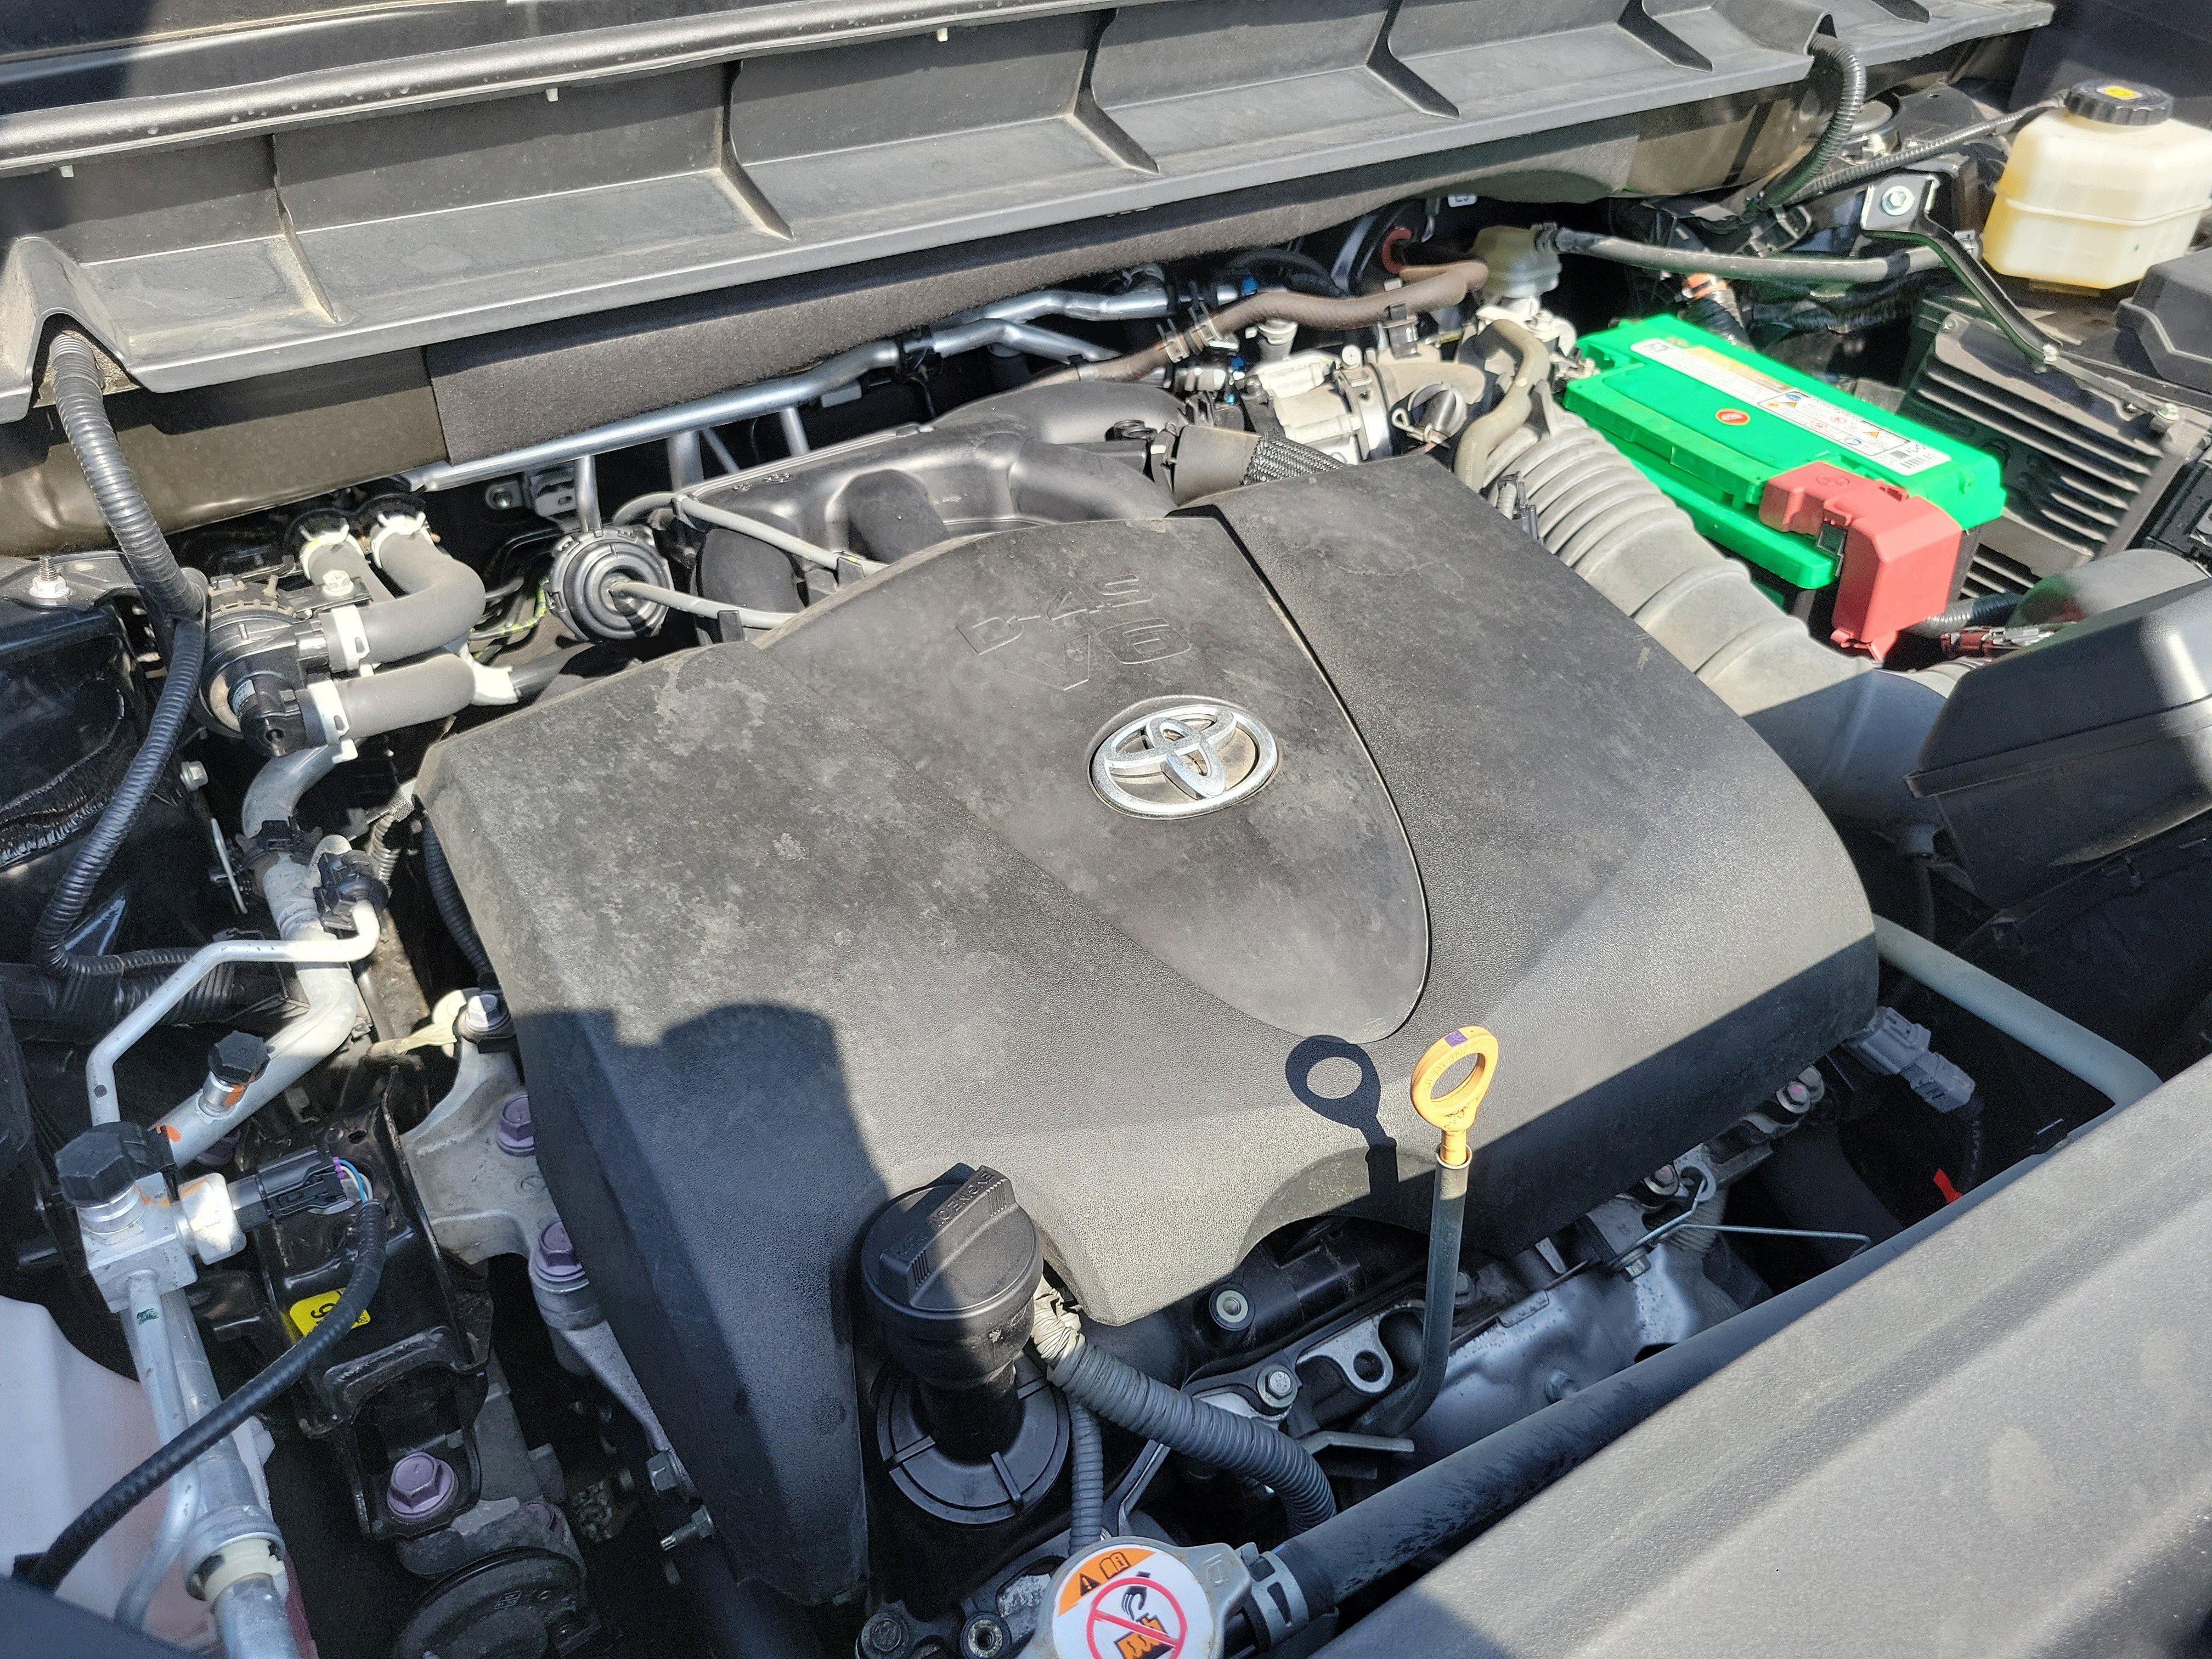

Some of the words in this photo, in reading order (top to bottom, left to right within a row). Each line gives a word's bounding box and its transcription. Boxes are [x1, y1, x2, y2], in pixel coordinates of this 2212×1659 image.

[956, 573, 1153, 656] D-4S
[1004, 617, 1192, 691] V6
[947, 1171, 995, 1212] ENGINE
